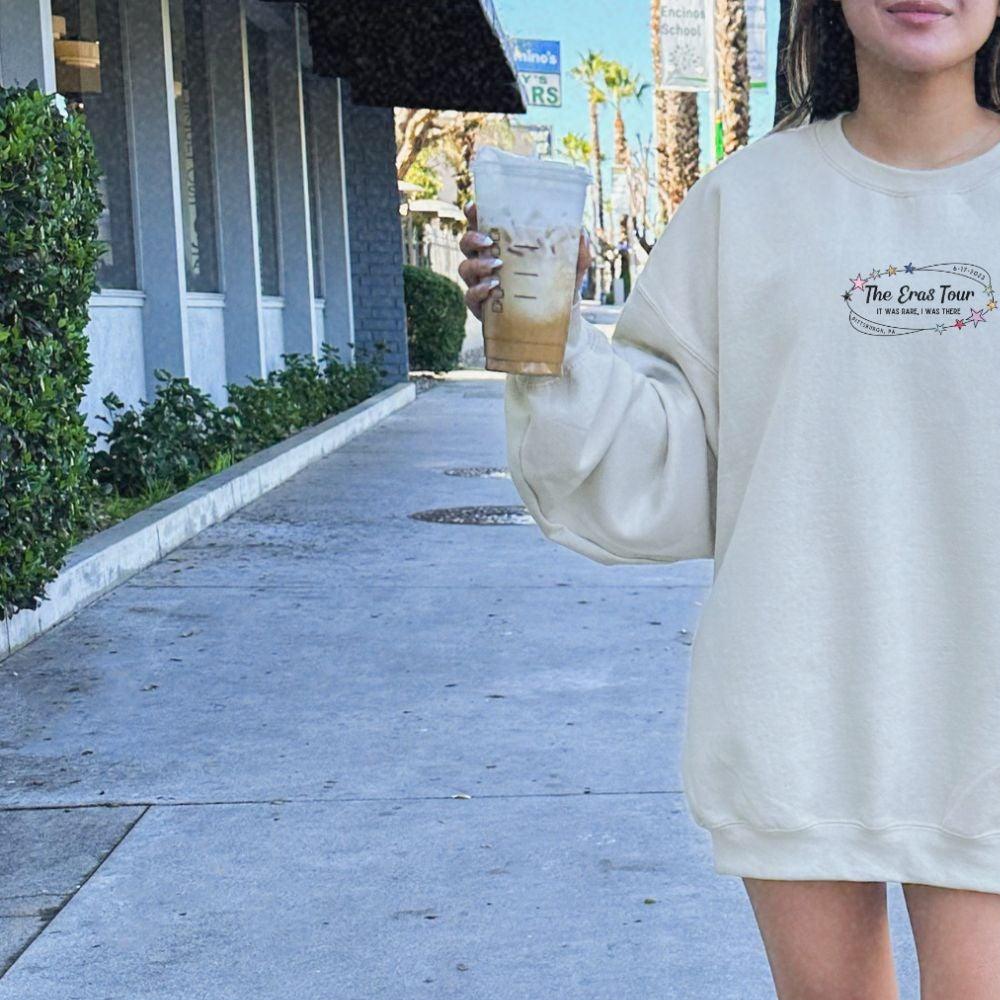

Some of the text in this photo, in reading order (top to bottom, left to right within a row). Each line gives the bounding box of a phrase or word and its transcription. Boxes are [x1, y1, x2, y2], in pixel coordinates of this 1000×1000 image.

[660, 23, 702, 36] School
[865, 285, 975, 304] The Eras Tour
